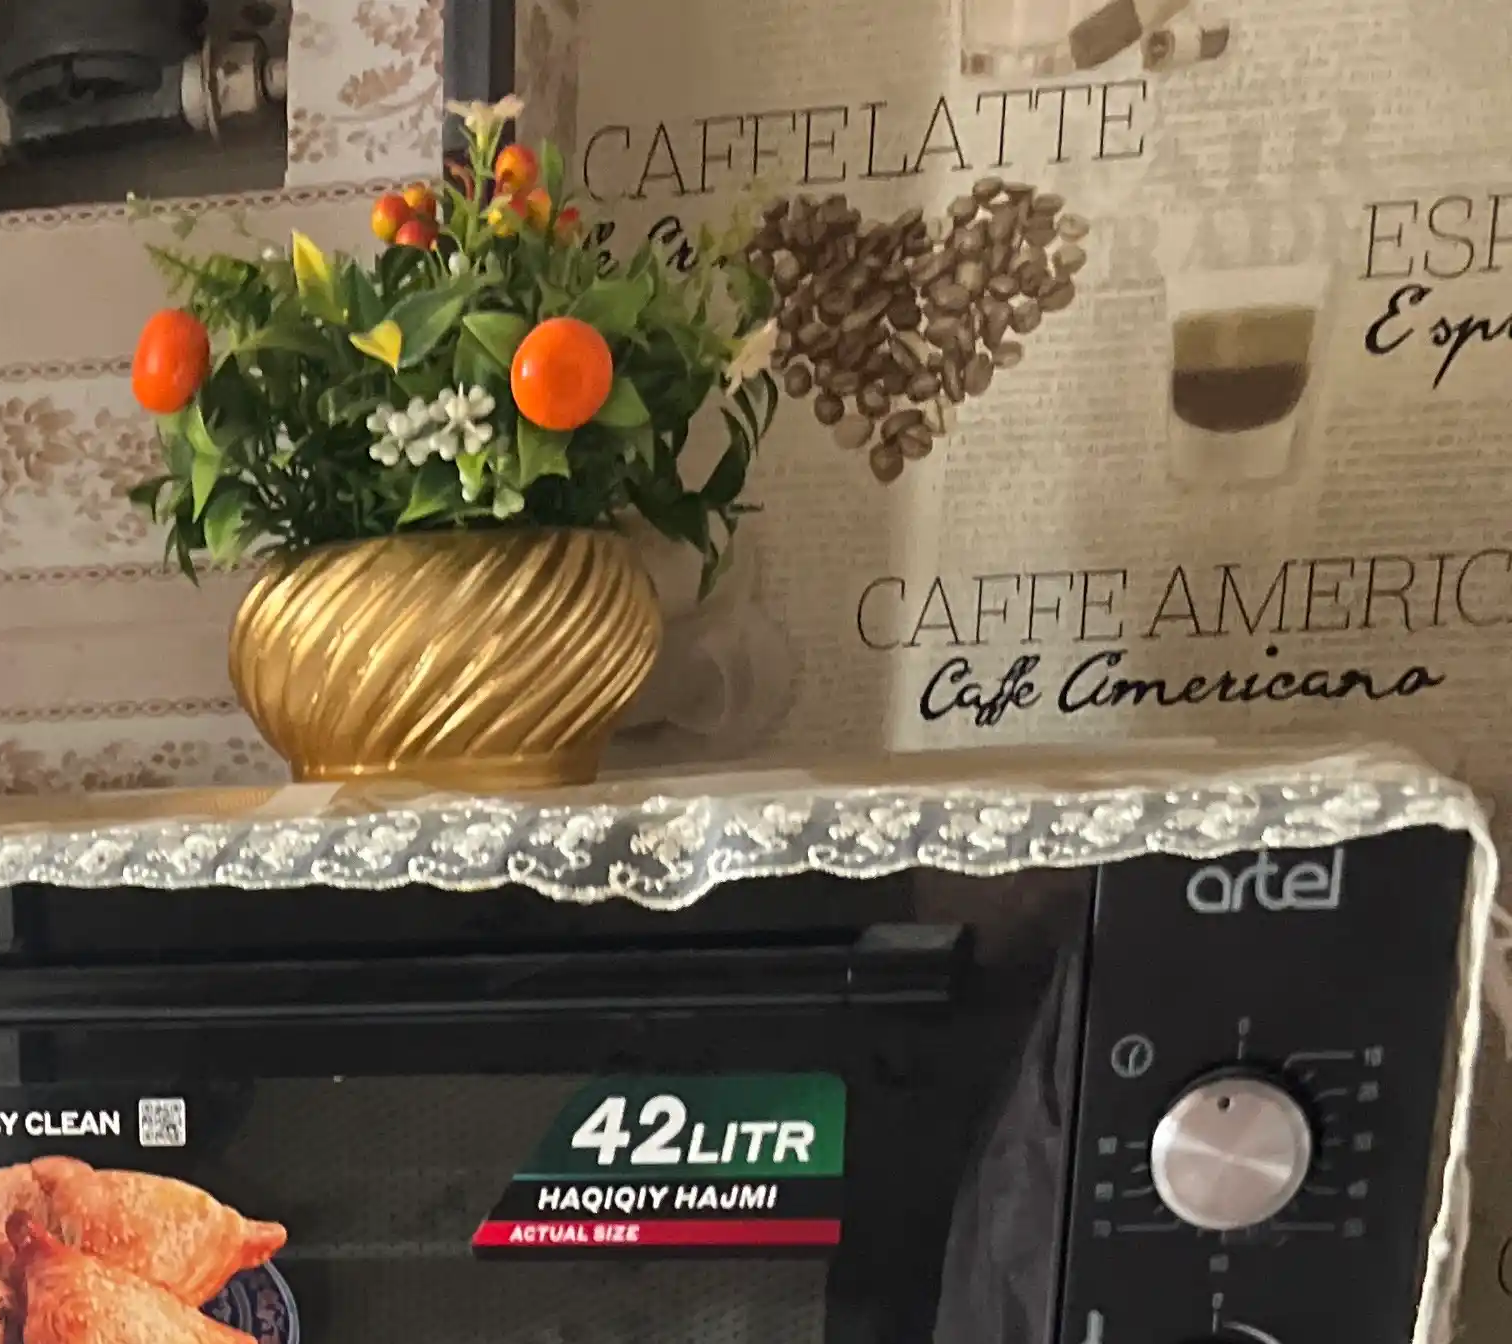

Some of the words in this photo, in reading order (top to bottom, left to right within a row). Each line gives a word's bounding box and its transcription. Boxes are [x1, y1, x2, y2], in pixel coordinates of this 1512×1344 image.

[856, 567, 1128, 651] CAFFE
[919, 653, 1043, 728] Caffe
[1187, 848, 1344, 912] artel
[24, 1109, 121, 1137] CLEAN
[571, 1094, 688, 1167] 42
[687, 1120, 816, 1164] LITR
[536, 1184, 669, 1214] HAQIQIY
[674, 1184, 778, 1211] HAJMI
[508, 1223, 589, 1243] ACTUAL
[593, 1223, 641, 1243] SIZE
